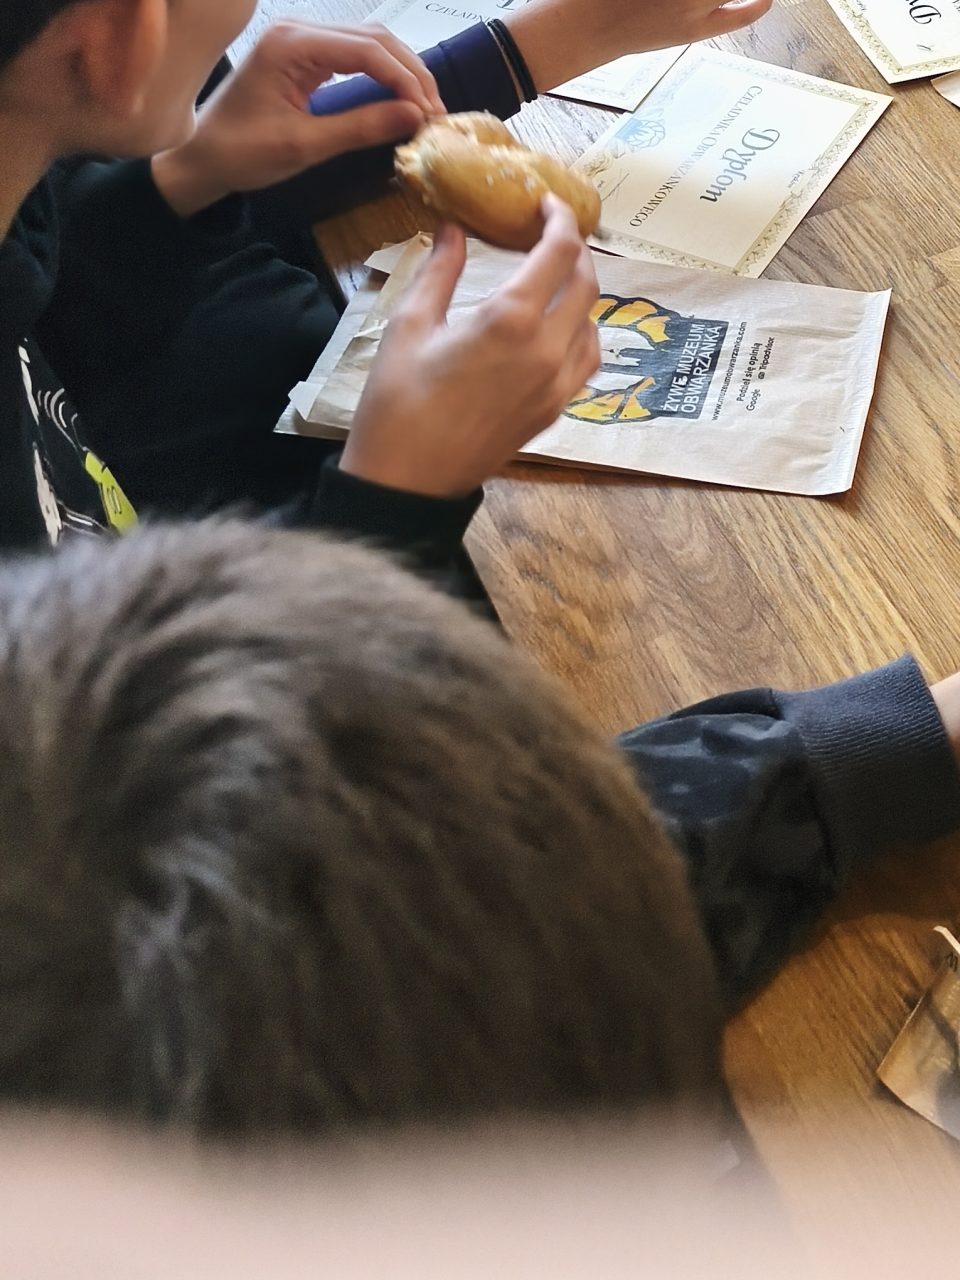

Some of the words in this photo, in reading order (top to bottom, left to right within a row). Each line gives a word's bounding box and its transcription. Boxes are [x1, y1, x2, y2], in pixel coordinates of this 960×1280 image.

[700, 128, 781, 203] Dyplom
[660, 375, 687, 413] ŻYWE
[676, 323, 706, 375] MUZEUM
[681, 326, 722, 413] OBWARZANKA
